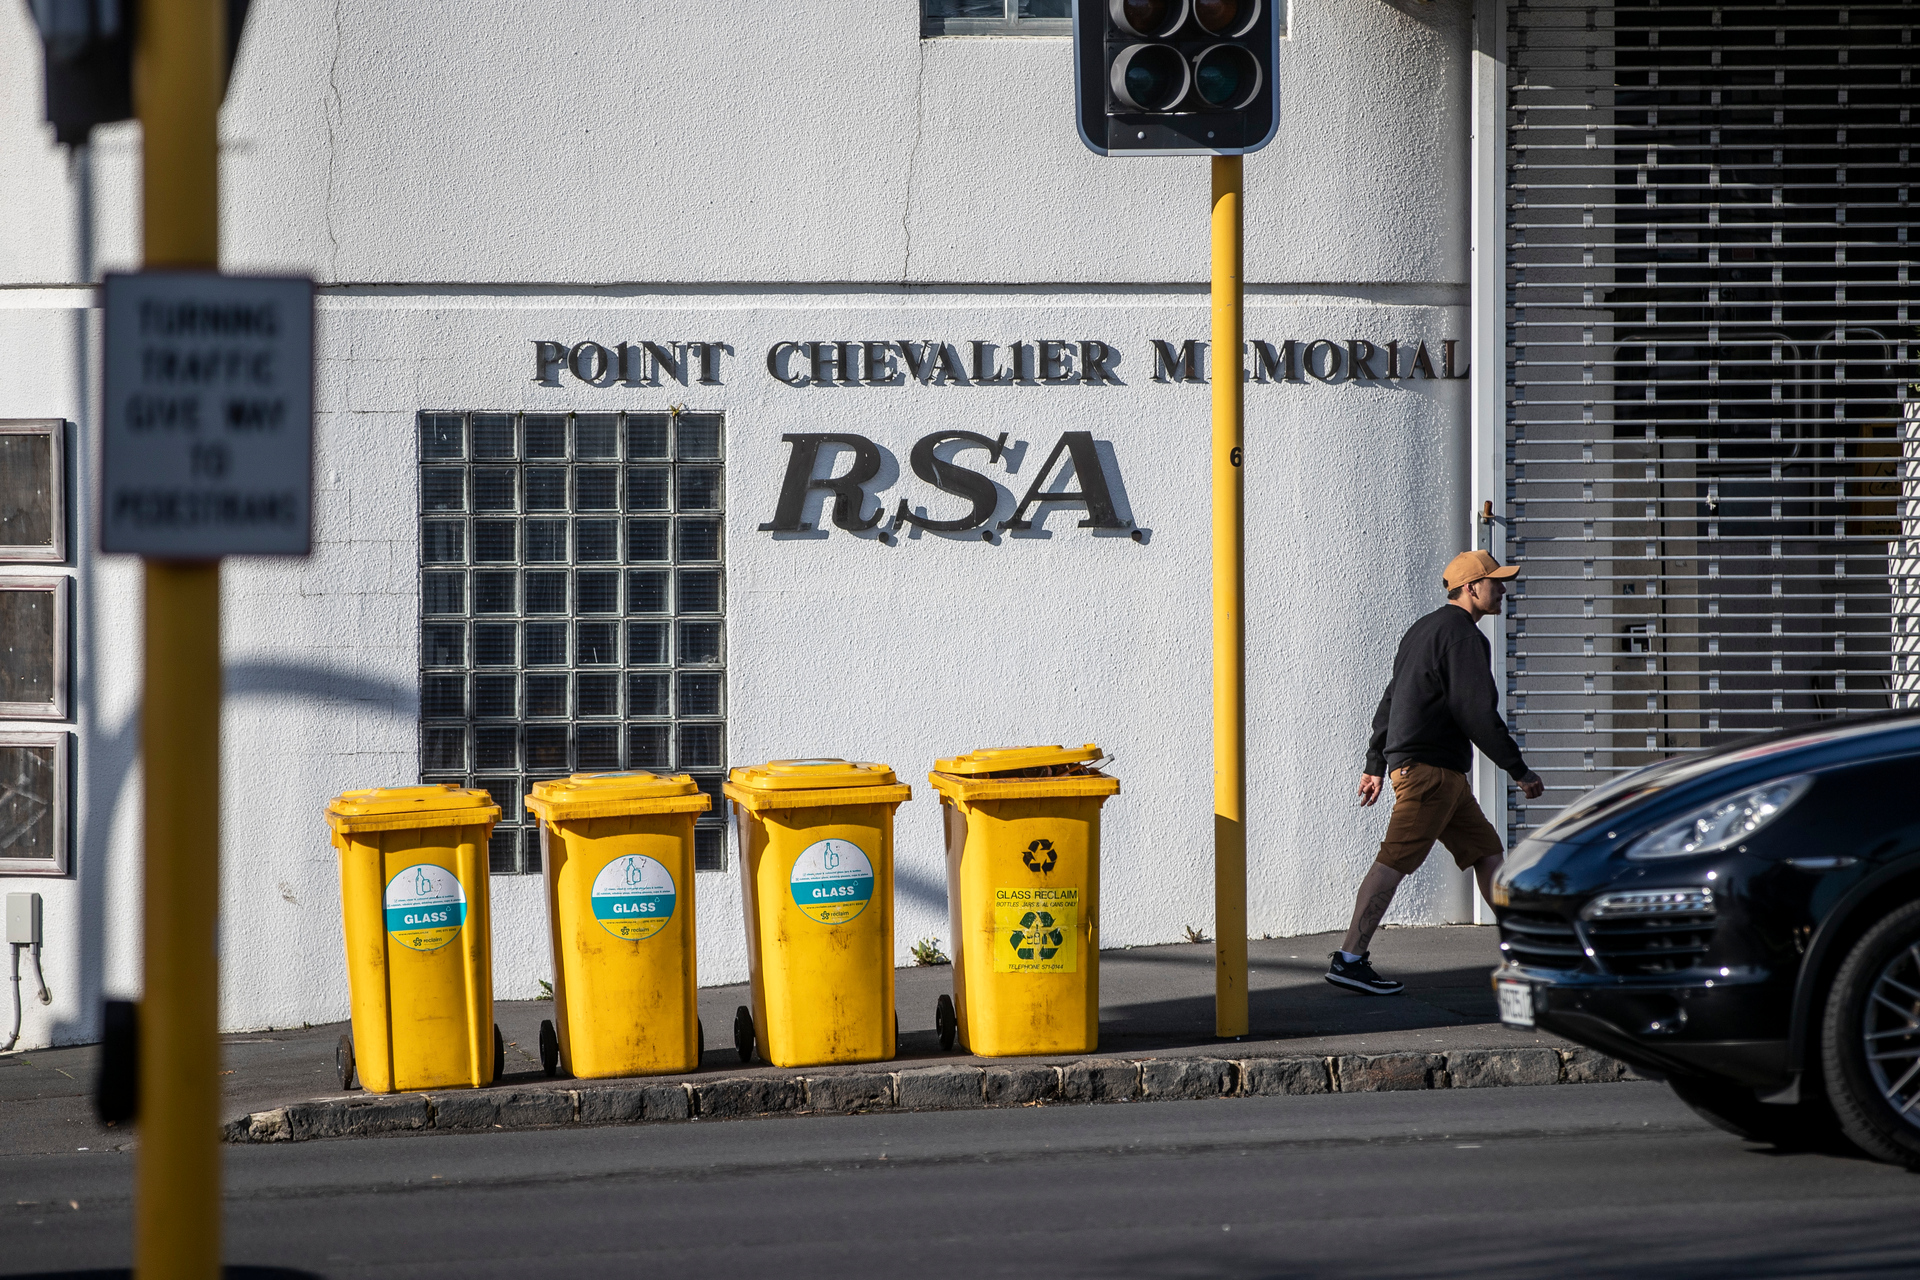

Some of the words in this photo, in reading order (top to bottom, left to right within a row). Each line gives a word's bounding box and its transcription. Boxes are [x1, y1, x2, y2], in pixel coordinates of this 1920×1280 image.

[530, 338, 728, 384] POINT
[767, 339, 1109, 383] CHEVALIER
[1150, 338, 1469, 381] MMORIAL
[1229, 446, 1243, 468] 6
[812, 886, 855, 898] GLASS
[996, 890, 1031, 899] GLASS
[1034, 890, 1077, 899] RECLAIM
[613, 902, 656, 913] GLASS
[404, 912, 447, 924] GLASS
